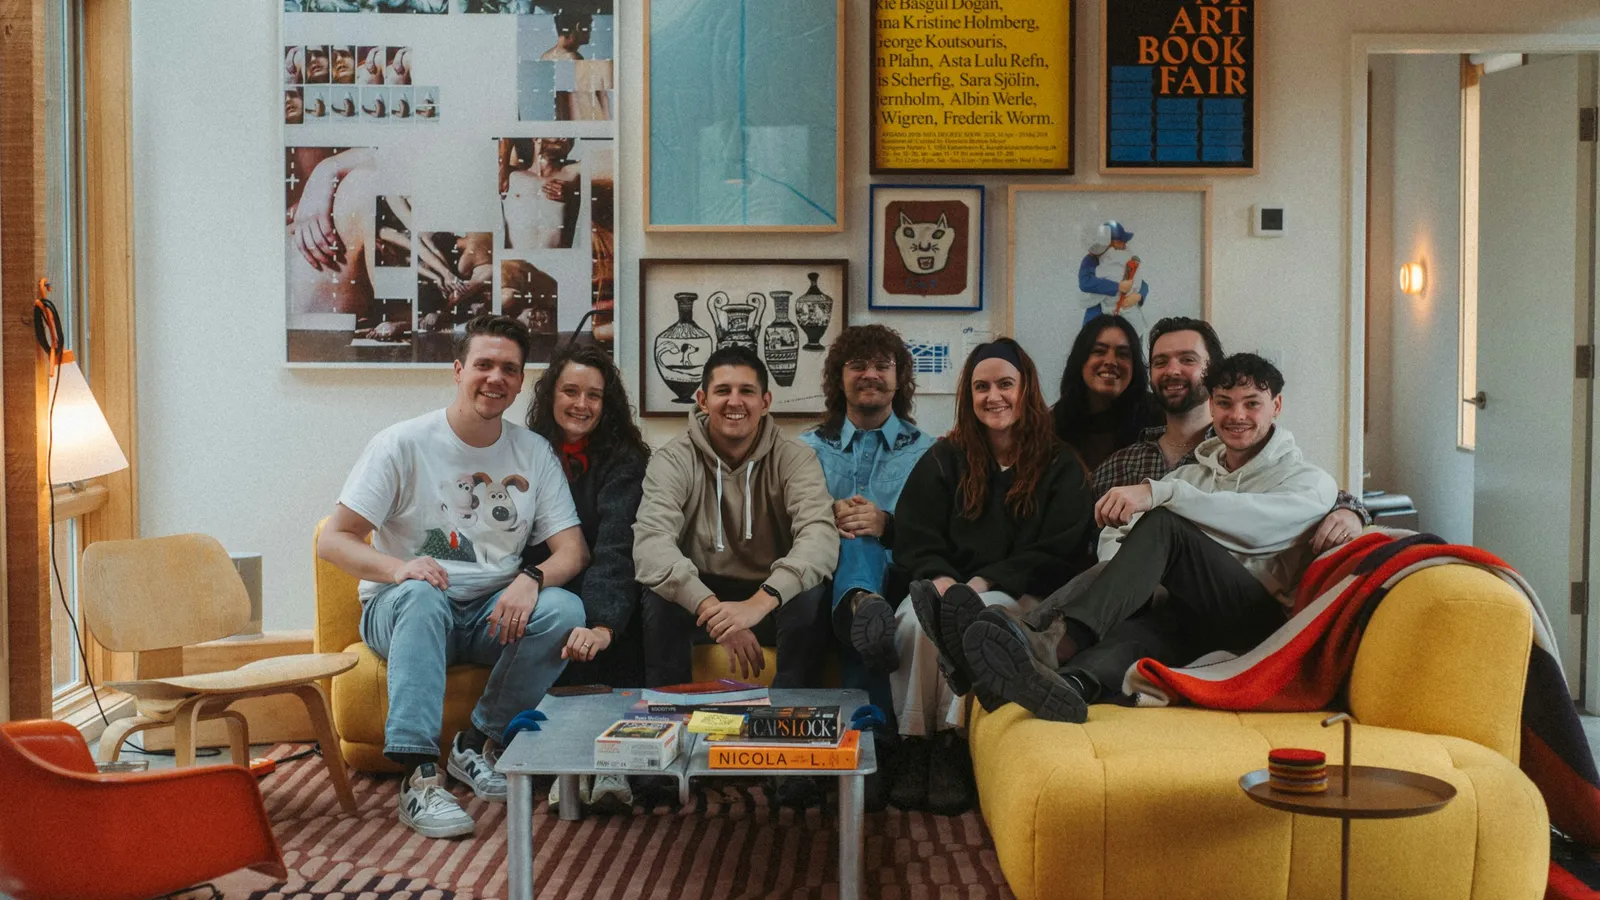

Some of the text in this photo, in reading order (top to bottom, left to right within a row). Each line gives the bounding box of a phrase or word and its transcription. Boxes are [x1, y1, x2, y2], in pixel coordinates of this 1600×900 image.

[903, 15, 961, 29] Kristine
[964, 15, 1040, 32] Holmberg,
[1168, 5, 1248, 35] ART
[925, 34, 1008, 50] Koutsouris,
[1137, 35, 1246, 65] BOOK
[889, 53, 933, 69] Plahn,
[938, 54, 971, 67] Asta
[975, 53, 1007, 67] Lulu
[1010, 53, 1049, 69] Refn,
[891, 72, 954, 90] Scherfig,
[960, 73, 991, 86] Sara
[994, 72, 1040, 90] Sjölin,
[1159, 66, 1248, 95] FAIR
[950, 92, 989, 106] Albin
[993, 92, 1037, 107] Werle,
[881, 111, 1055, 128] Wigren, Frederik Worm.
[753, 719, 831, 737] CAPS LOCK
[719, 752, 788, 766] NICOLA
[811, 753, 826, 766] L.
